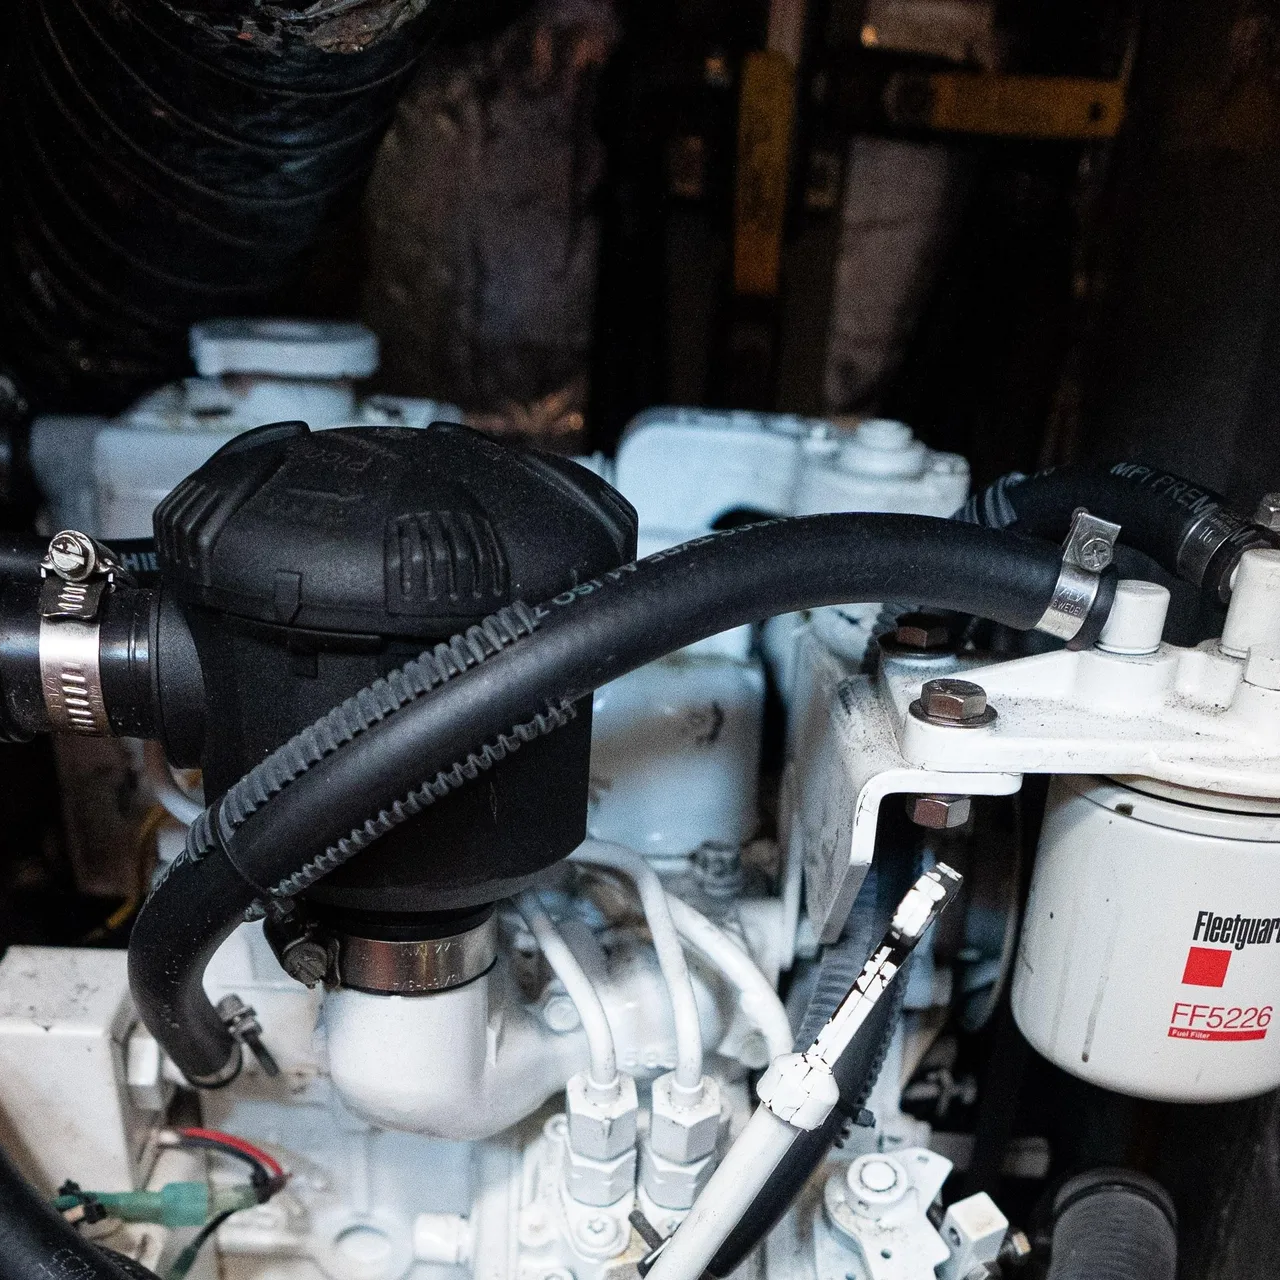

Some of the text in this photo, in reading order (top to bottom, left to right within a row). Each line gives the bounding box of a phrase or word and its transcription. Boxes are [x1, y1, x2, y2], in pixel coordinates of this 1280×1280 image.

[1170, 1001, 1274, 1030] FF5226
[1172, 1028, 1211, 1039] Fuel Filter
